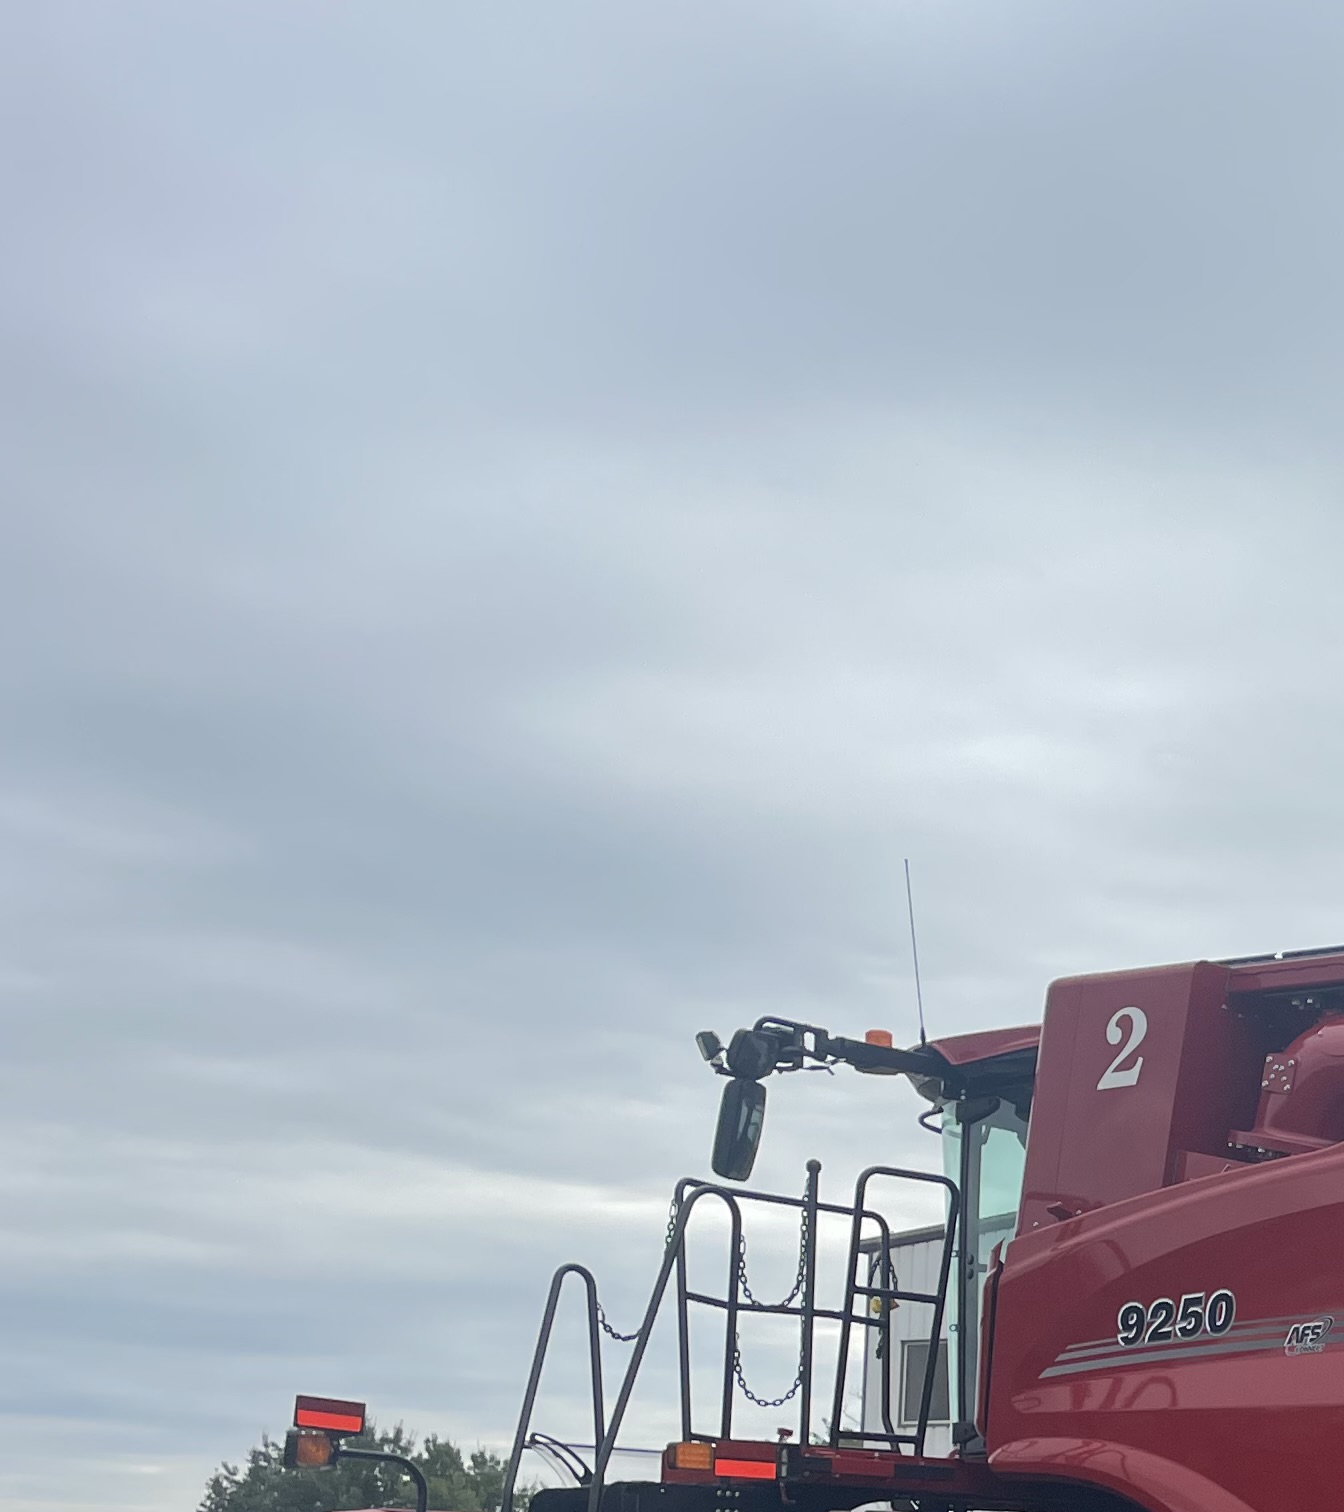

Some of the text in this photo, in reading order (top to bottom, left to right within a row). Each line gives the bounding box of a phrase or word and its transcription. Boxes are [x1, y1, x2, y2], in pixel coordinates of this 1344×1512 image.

[1097, 1006, 1147, 1090] 2
[1117, 1289, 1237, 1348] 9250
[1284, 1322, 1325, 1346] AFS
